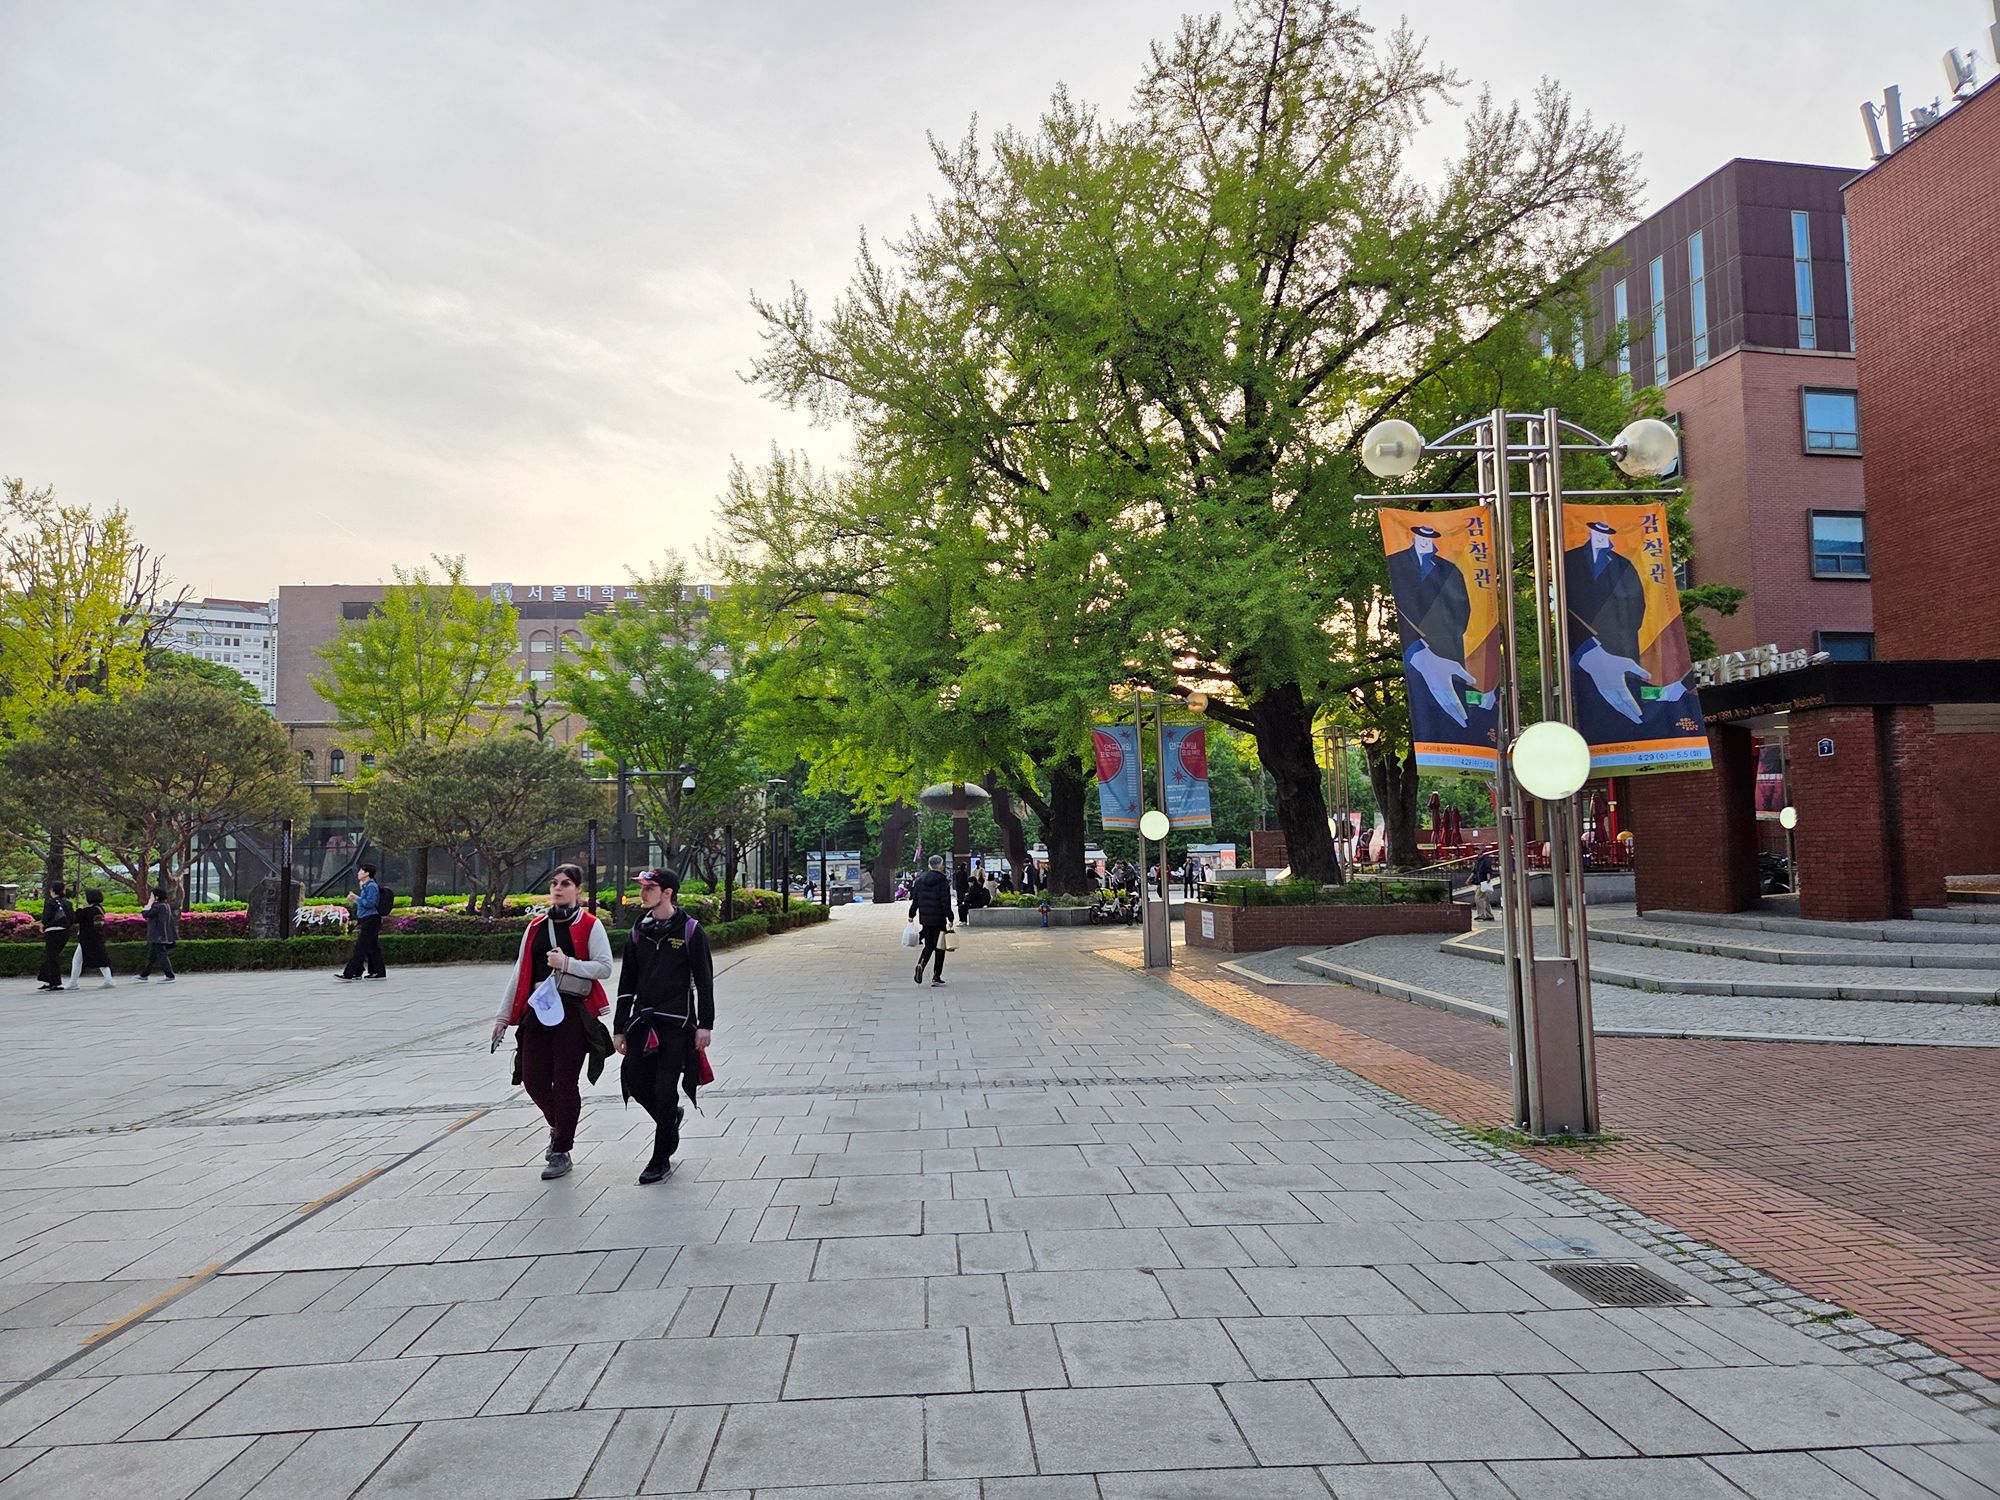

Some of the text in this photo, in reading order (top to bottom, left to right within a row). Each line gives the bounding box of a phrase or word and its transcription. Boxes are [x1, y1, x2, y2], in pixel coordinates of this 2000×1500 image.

[1464, 517, 1491, 589] 감찰관
[1639, 514, 1666, 584] 감찰관
[527, 585, 638, 601] 서울대학교
